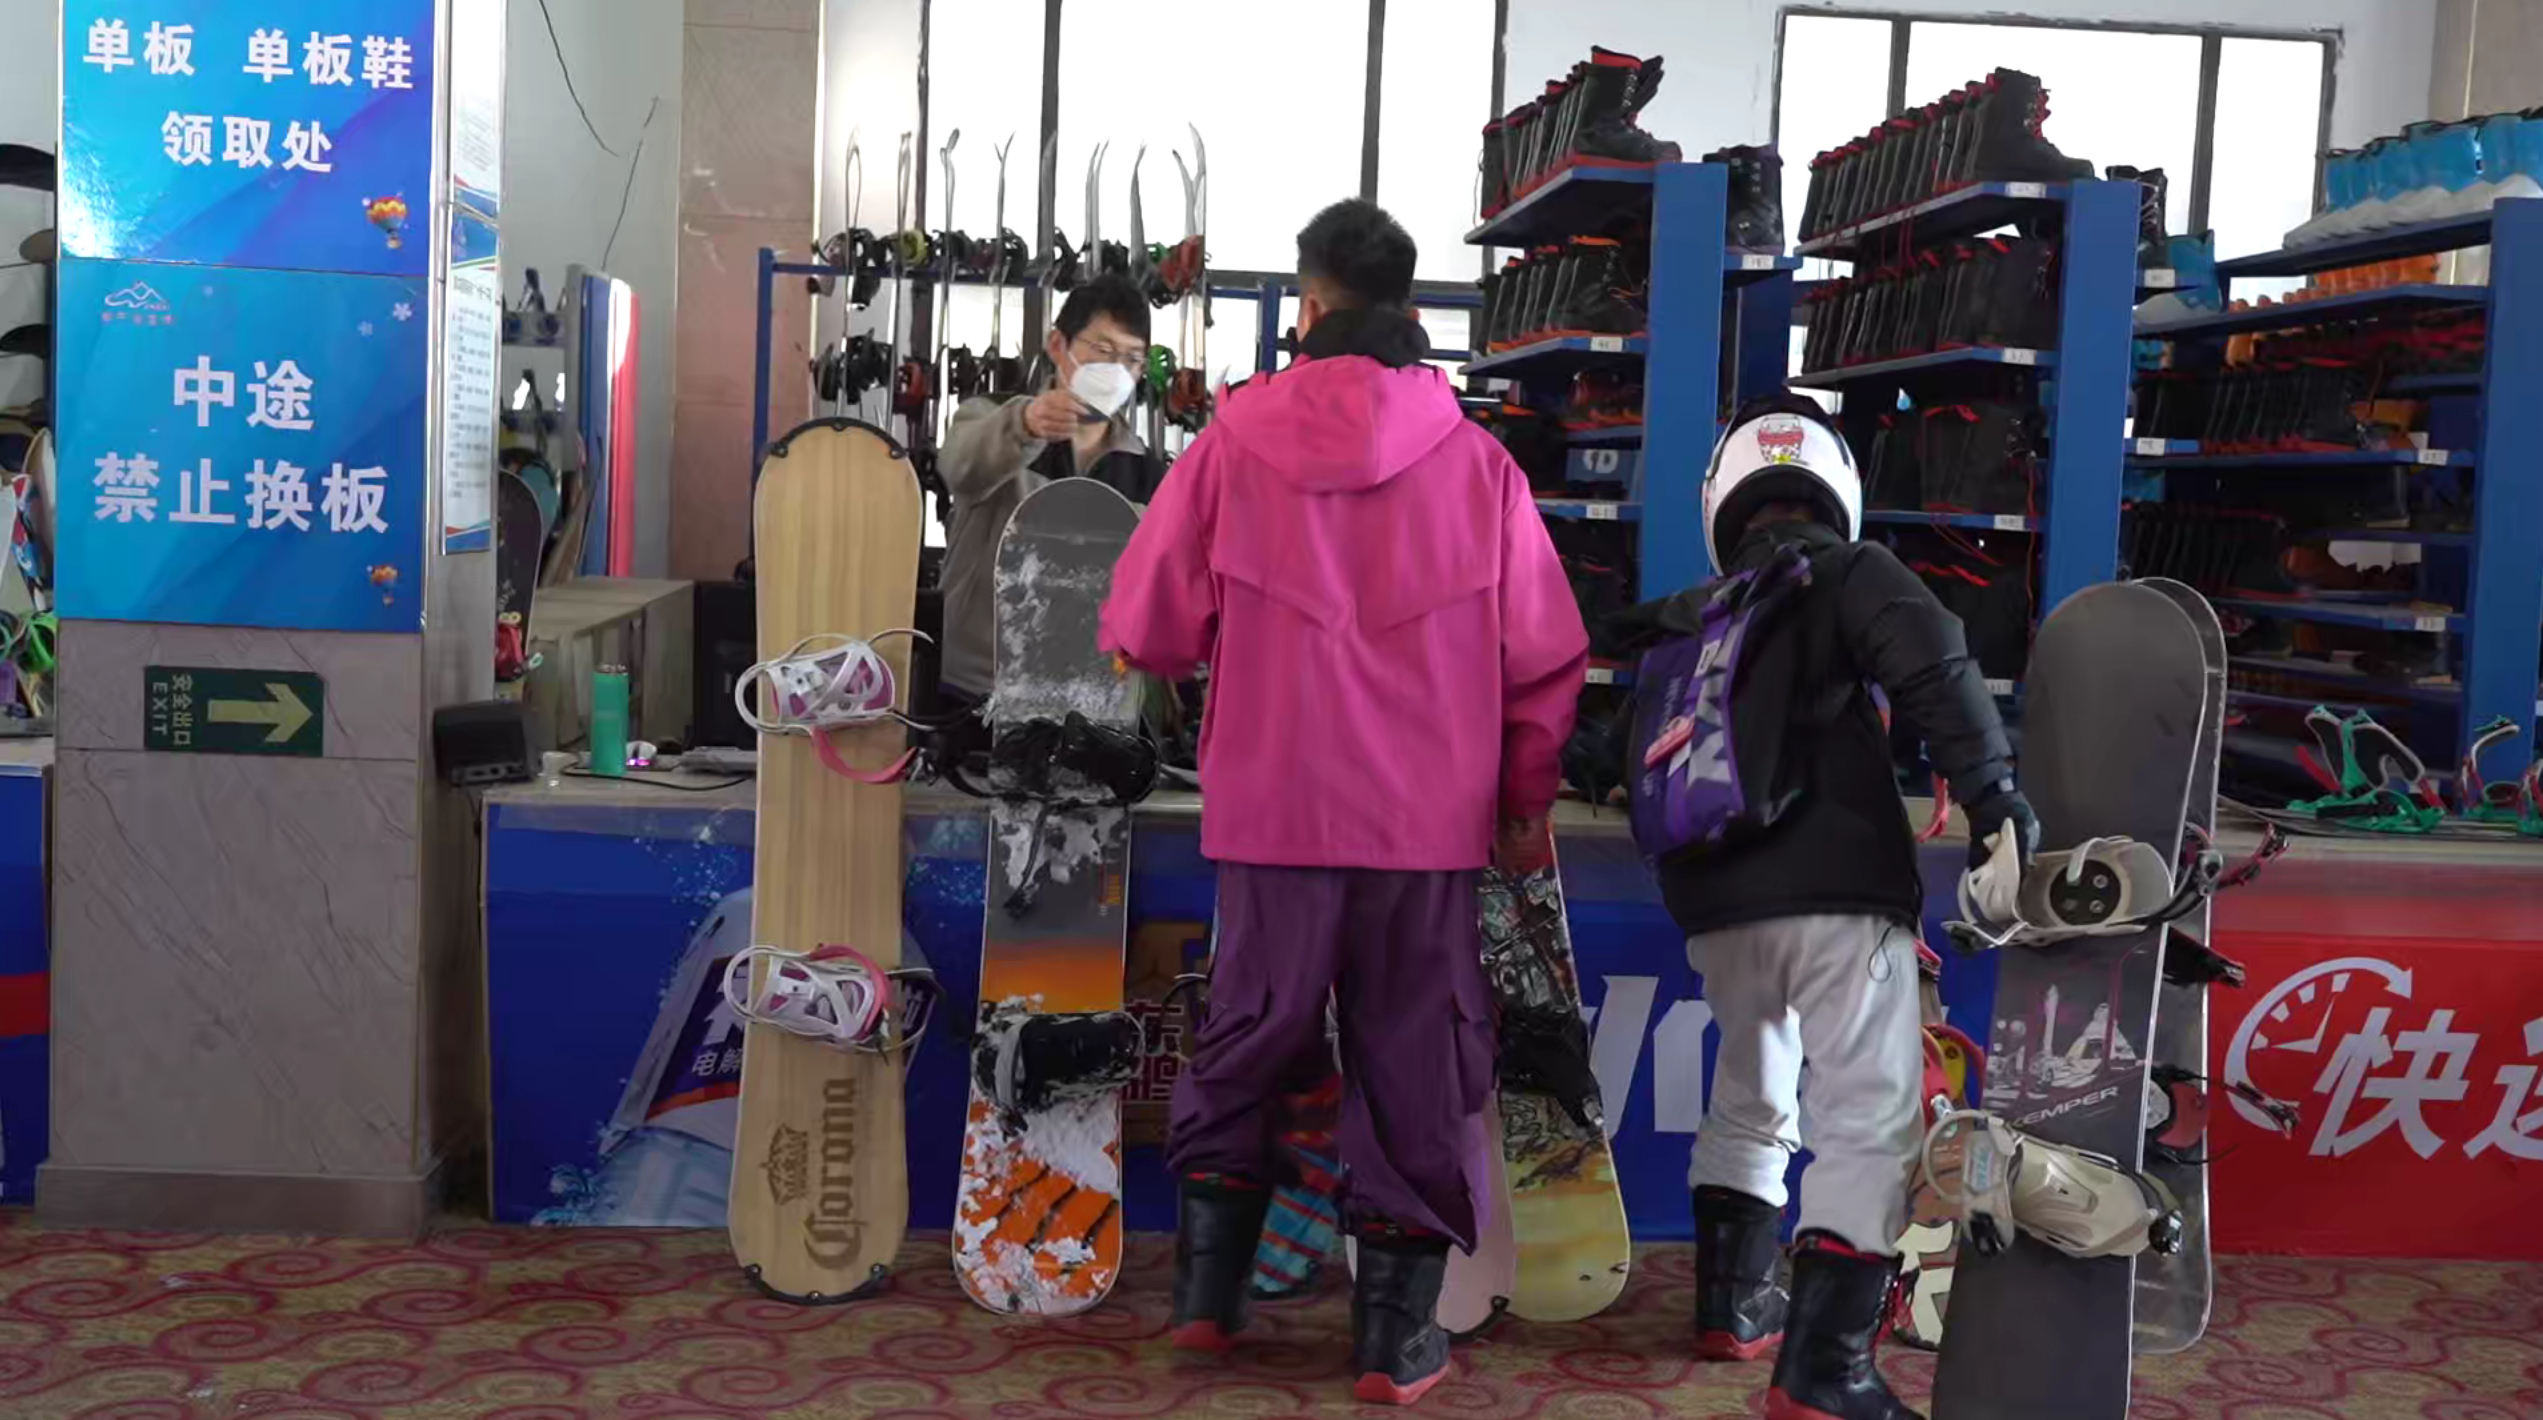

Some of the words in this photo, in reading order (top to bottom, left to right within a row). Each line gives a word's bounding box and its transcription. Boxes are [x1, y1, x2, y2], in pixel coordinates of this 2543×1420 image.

[83, 19, 195, 76] 单板
[243, 29, 414, 90] 单板鞋
[161, 111, 333, 173] 领取处
[173, 355, 314, 431] 中途
[93, 452, 389, 533] 禁止换板
[153, 682, 169, 735] EXIT
[172, 674, 193, 746] 安全出口
[803, 1077, 870, 1271] Corona
